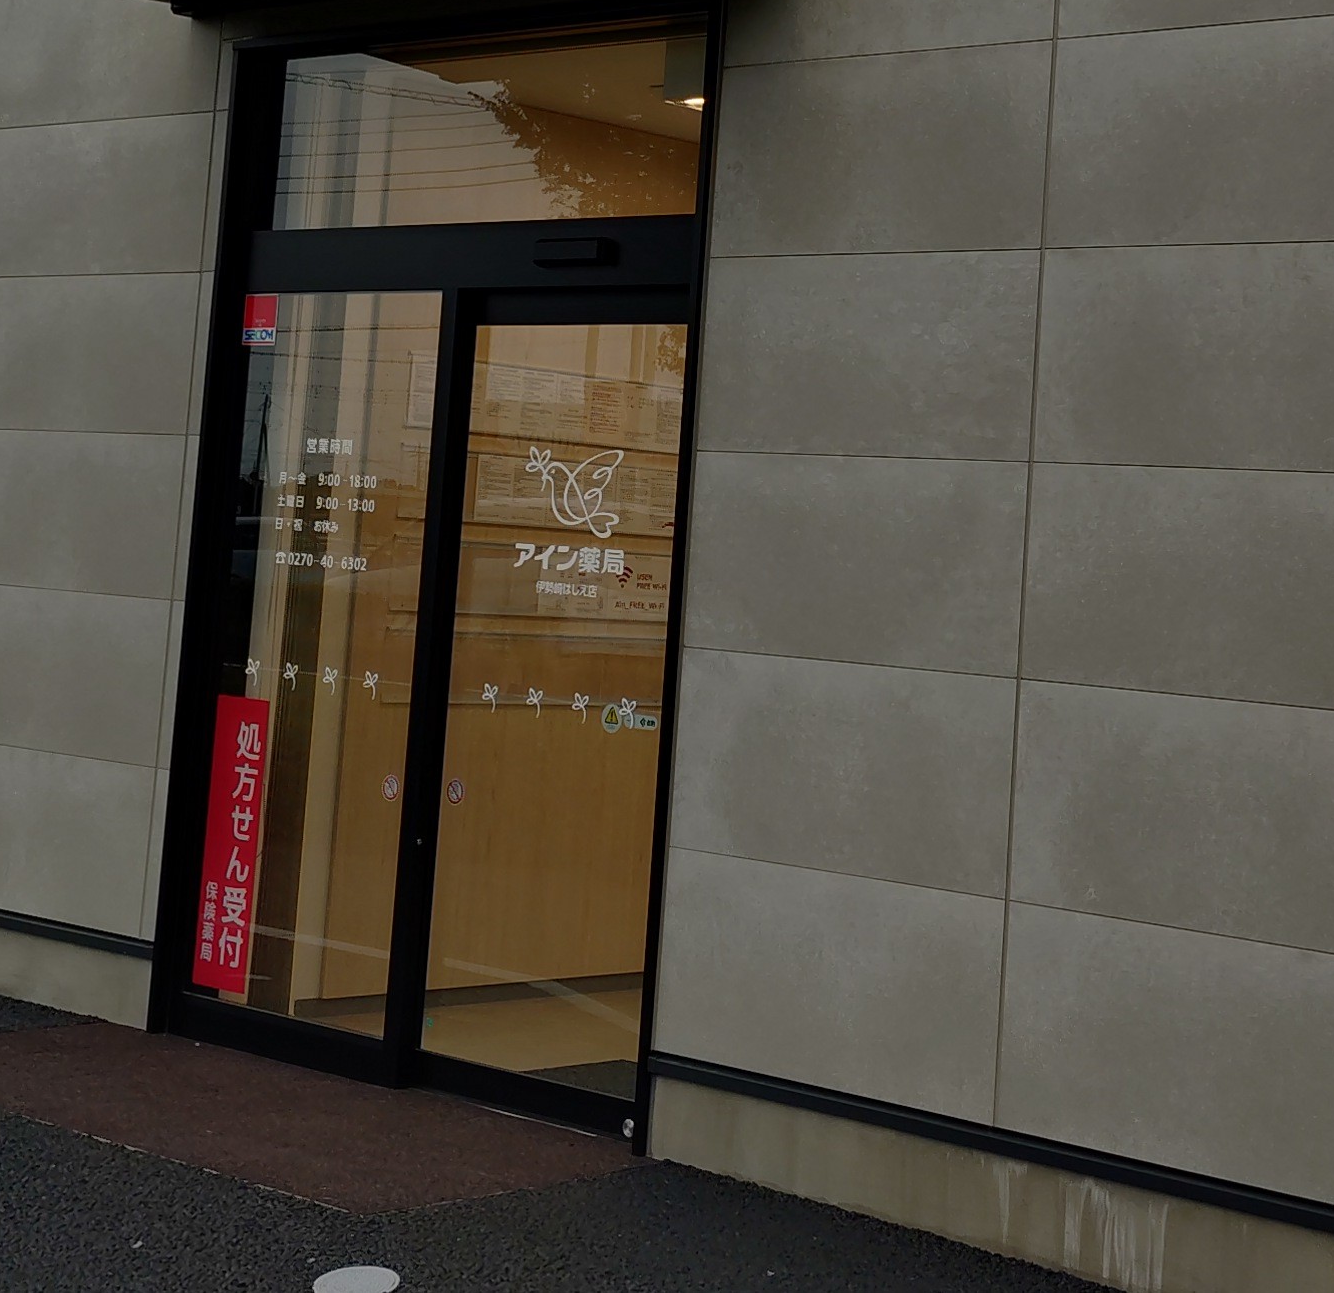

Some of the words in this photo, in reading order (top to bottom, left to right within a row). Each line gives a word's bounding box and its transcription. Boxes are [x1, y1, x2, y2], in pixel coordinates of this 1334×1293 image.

[245, 329, 274, 341] SECOM
[306, 438, 353, 455] 営業時間
[277, 493, 305, 508] 土曜日
[313, 520, 339, 534] お休み
[513, 542, 625, 575] アイン薬局
[535, 580, 598, 599] 伊勢崎はしえ店
[218, 721, 262, 969] 処方せん受付
[200, 880, 219, 963] 保険薬局
